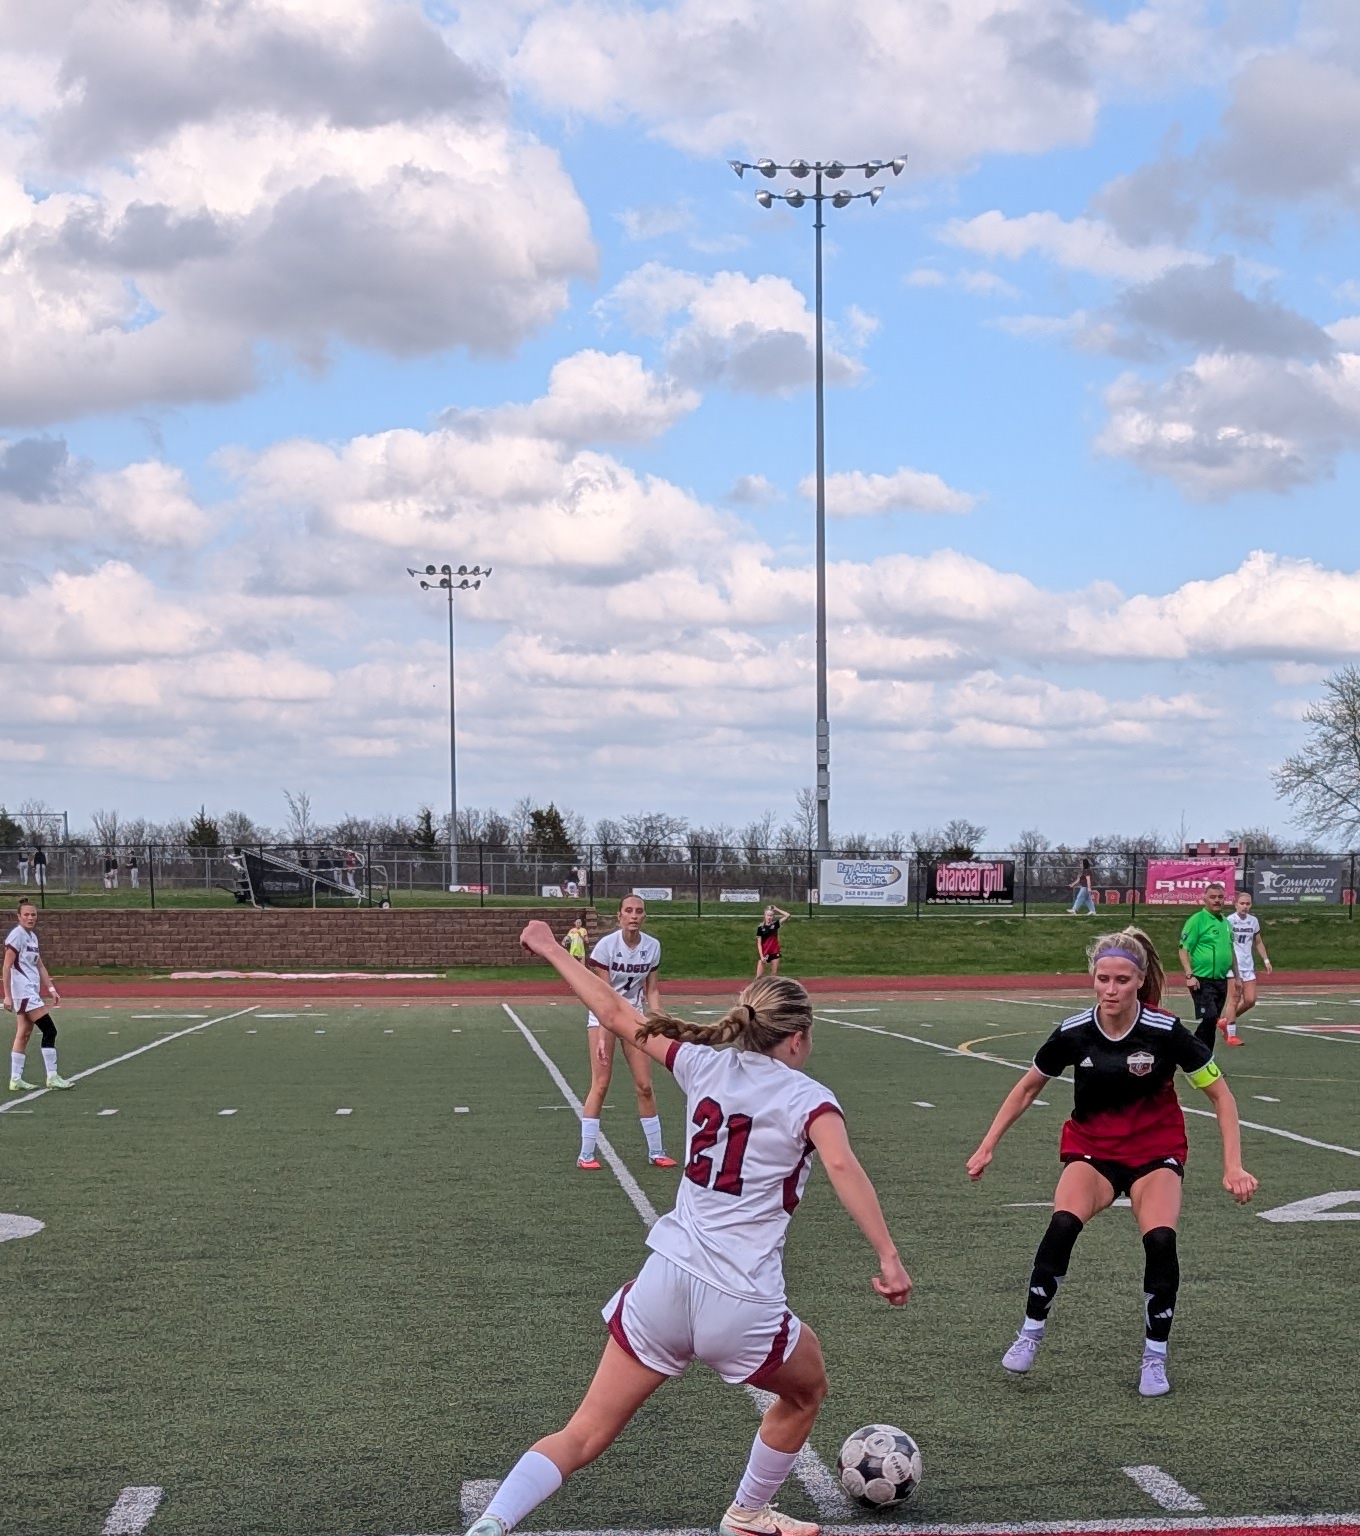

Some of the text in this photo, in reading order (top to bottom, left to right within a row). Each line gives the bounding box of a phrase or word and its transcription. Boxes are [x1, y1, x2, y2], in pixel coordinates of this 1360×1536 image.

[837, 862, 894, 874] Ray Alderman
[852, 876, 871, 885] Sons
[936, 864, 980, 891] charcoal
[1272, 874, 1337, 887] COMMUNITY
[624, 977, 634, 991] 1
[684, 1096, 753, 1197] 21
